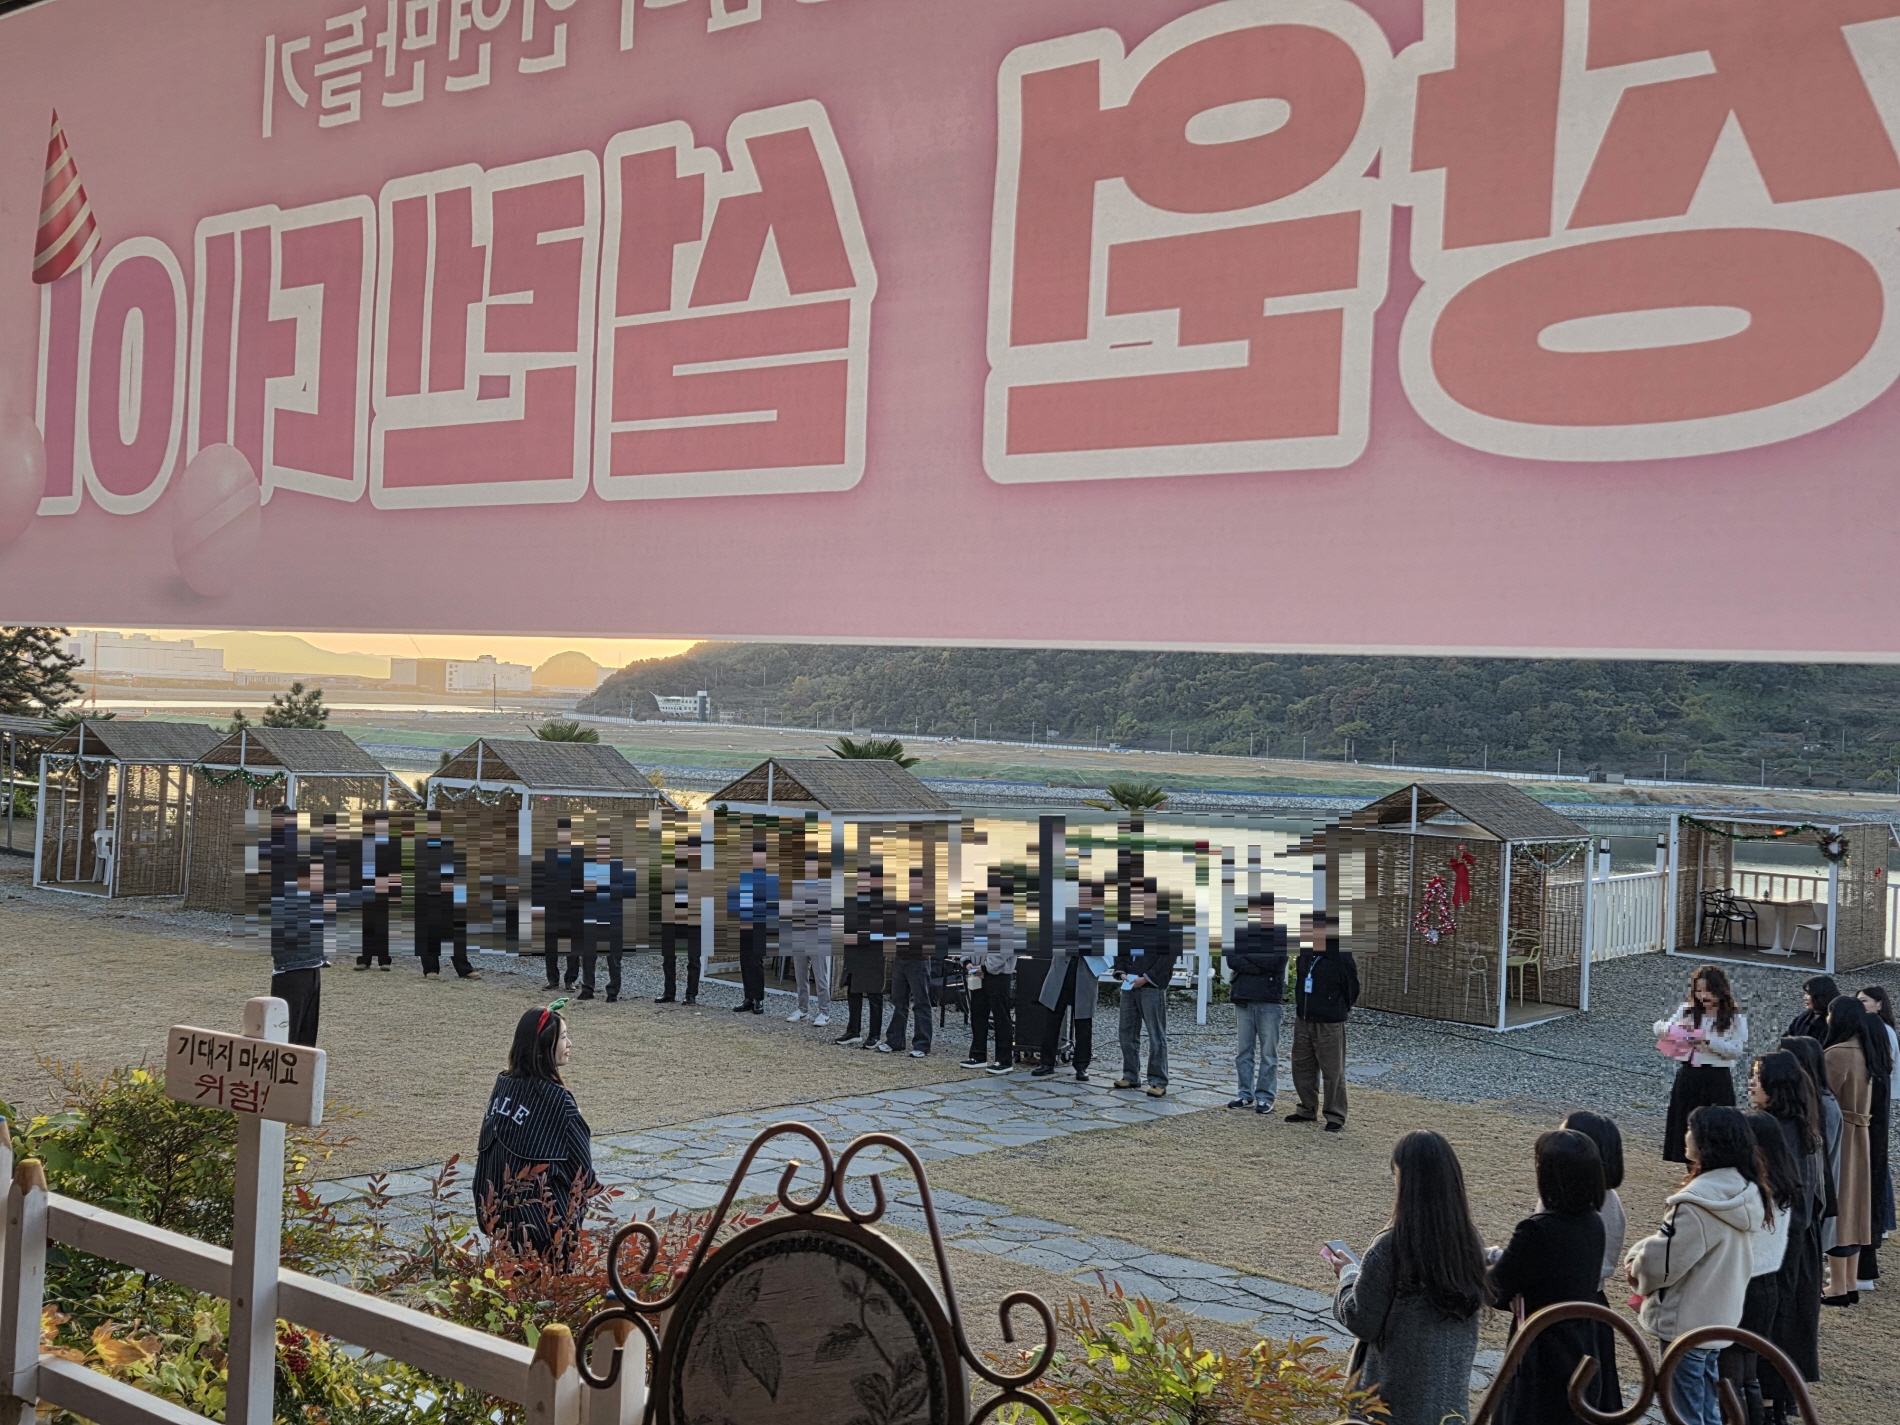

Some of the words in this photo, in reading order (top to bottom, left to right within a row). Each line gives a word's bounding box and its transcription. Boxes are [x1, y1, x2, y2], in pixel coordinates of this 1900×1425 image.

[177, 1033, 234, 1072] 기대지
[238, 1043, 299, 1085] 마세요
[194, 1073, 270, 1113] 위험!
